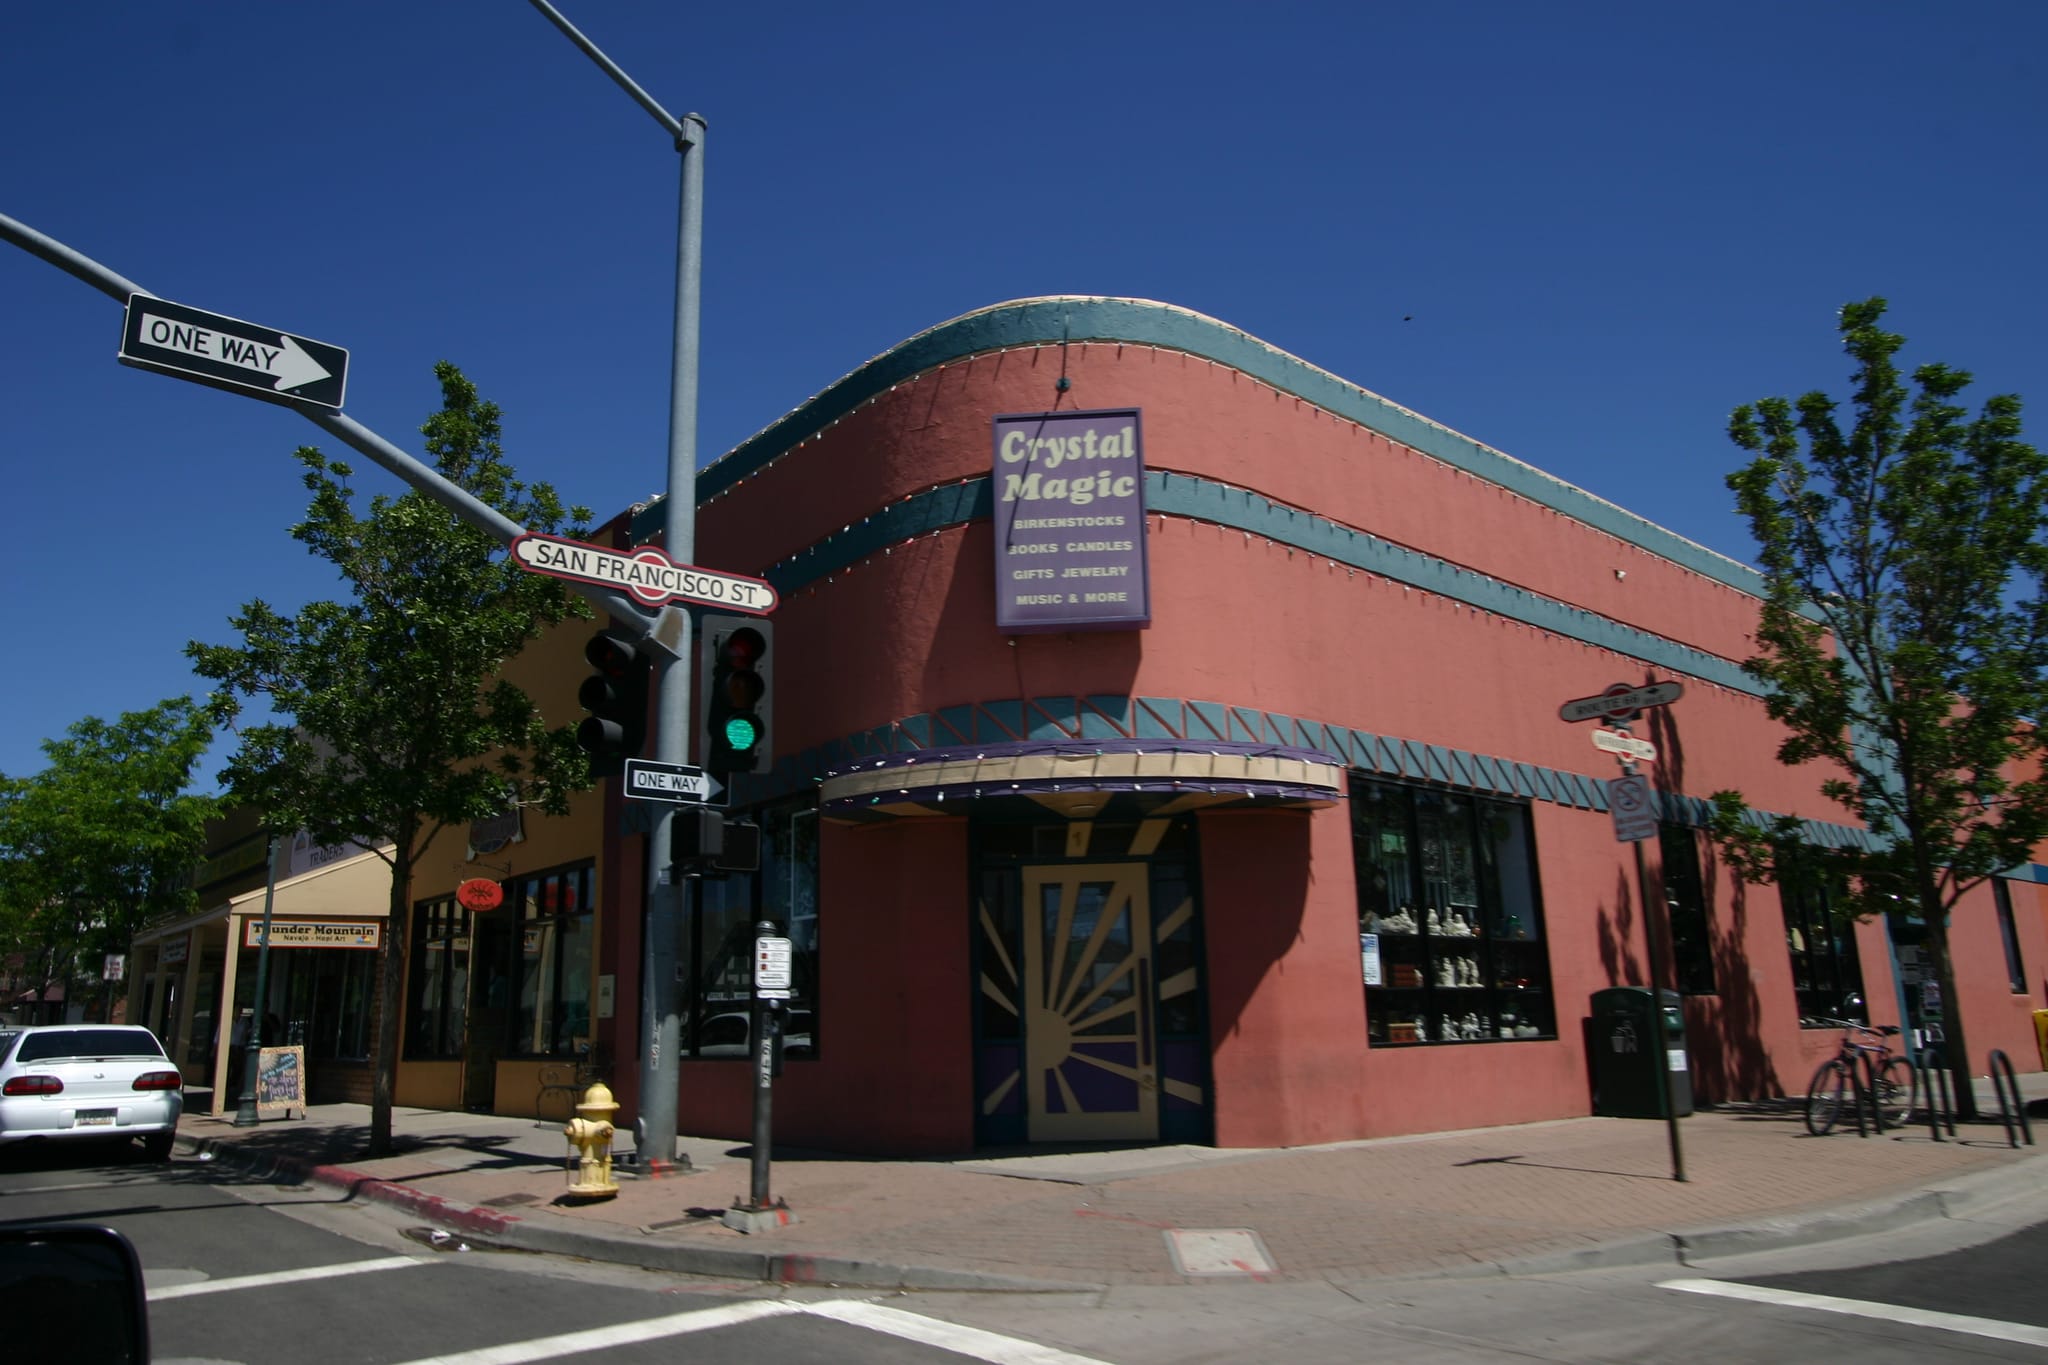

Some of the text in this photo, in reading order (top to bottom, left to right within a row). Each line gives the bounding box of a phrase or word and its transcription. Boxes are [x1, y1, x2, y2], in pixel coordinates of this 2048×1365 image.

[151, 320, 280, 370] ONE WAY
[1000, 425, 1136, 468] Crystal
[1001, 470, 1136, 505] Magic
[1013, 515, 1126, 530] BIRKENSTOCKS
[1066, 541, 1133, 553] CANDLES
[535, 543, 758, 604] SAN FRANCISCO ST
[1012, 566, 1129, 580] GIFTS JEWELRY
[1016, 592, 1128, 605] MUSIC & MORE
[637, 772, 700, 791] ONE WAY
[253, 924, 375, 936] Tunder Mountain
[283, 934, 309, 942] Navajo
